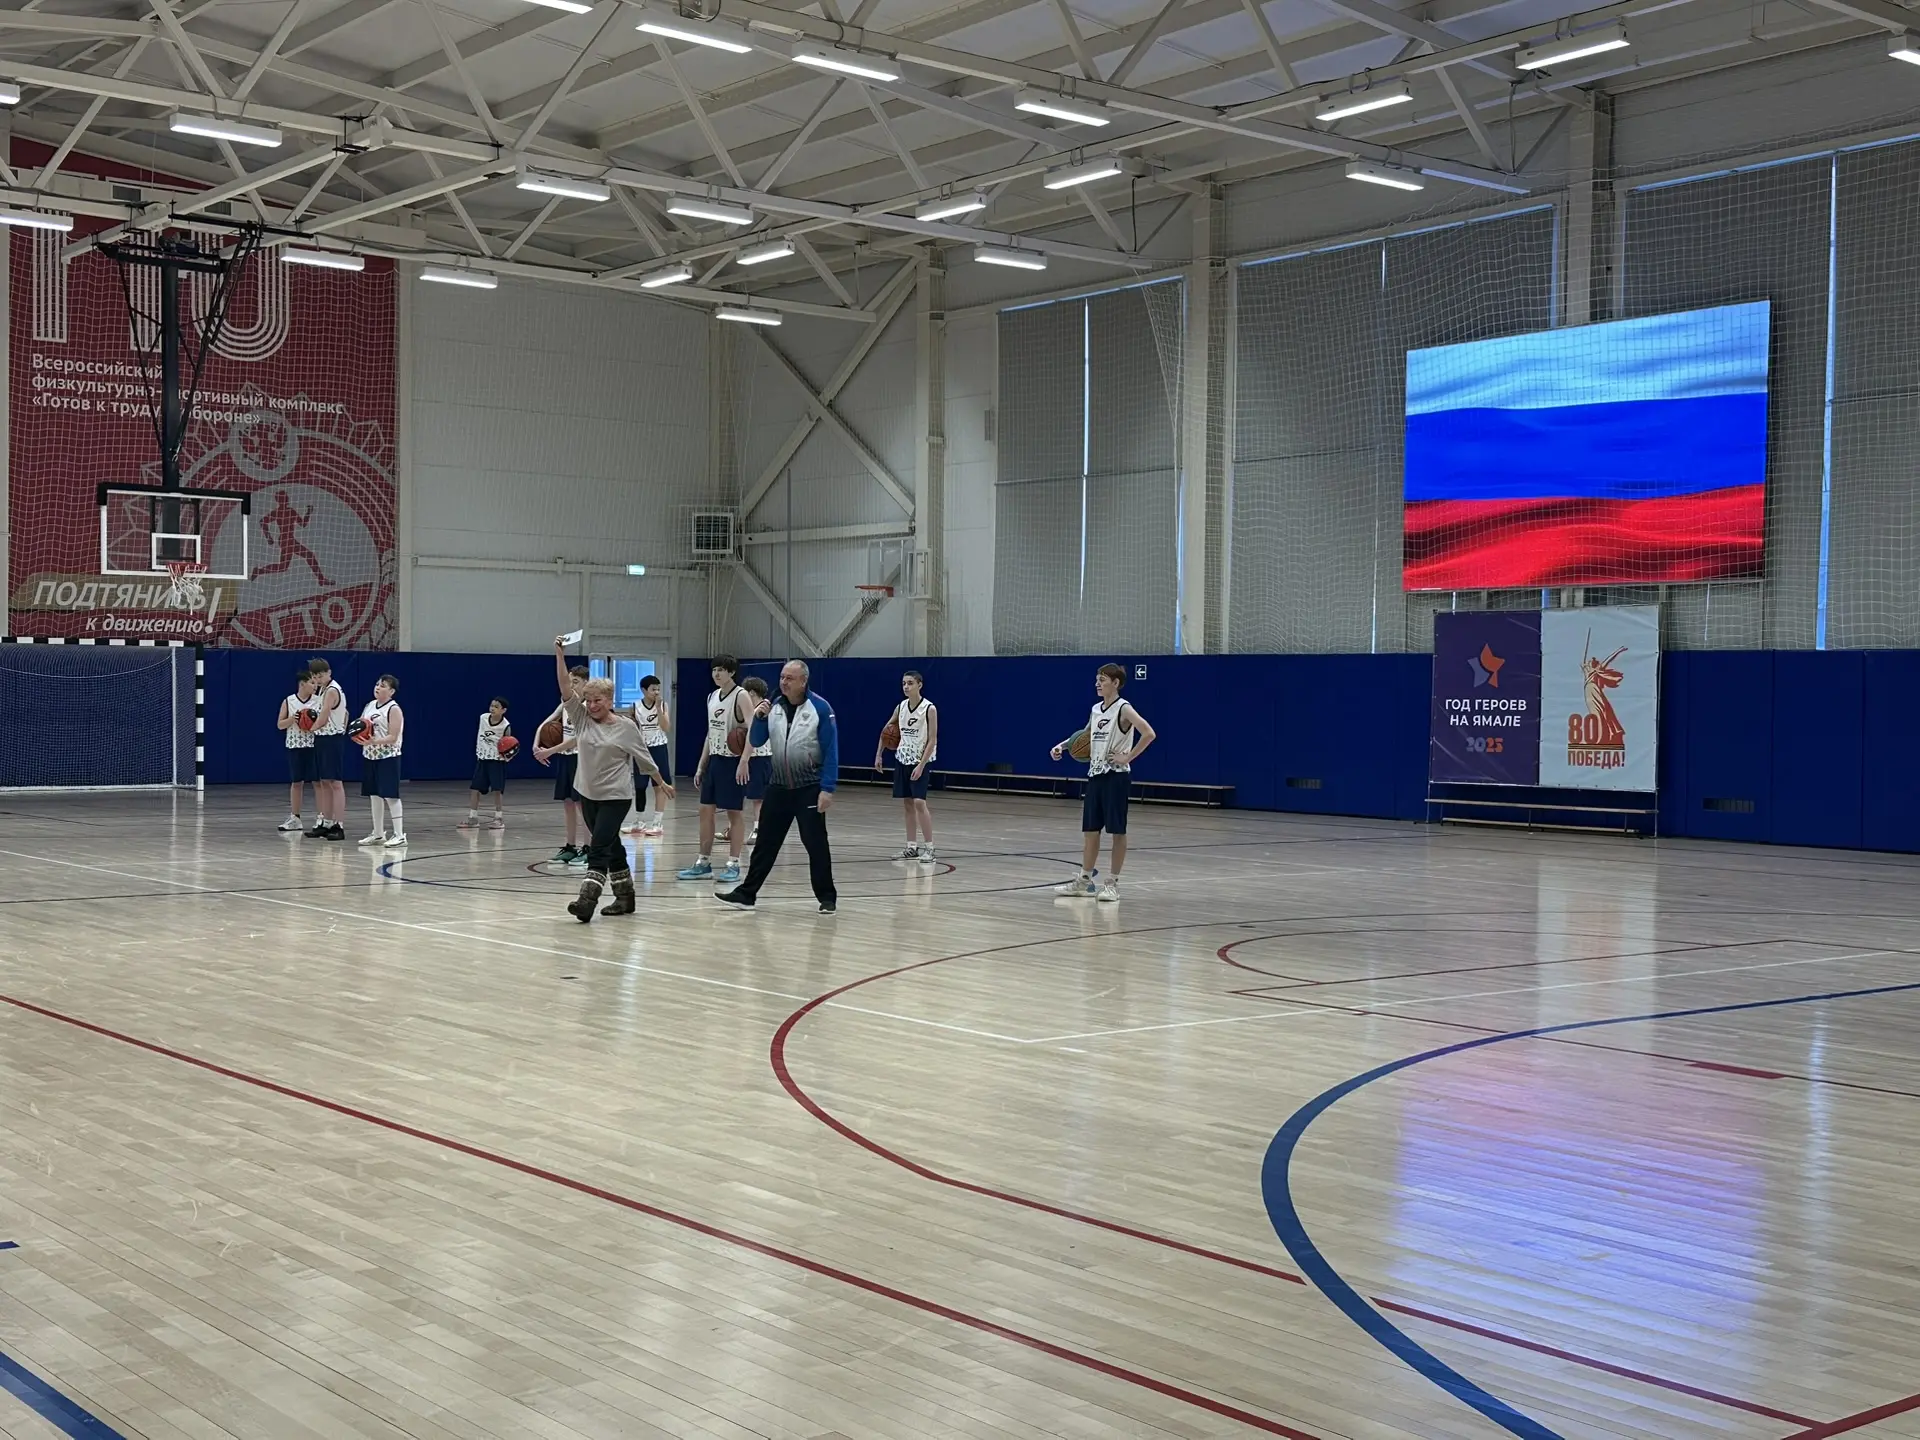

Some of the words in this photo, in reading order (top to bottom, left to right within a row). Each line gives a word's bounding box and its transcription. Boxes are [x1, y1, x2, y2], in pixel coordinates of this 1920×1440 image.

[32, 353, 162, 379] Всероссийский
[32, 373, 264, 408] физкультурно-ортивный
[268, 397, 344, 415] комплекс
[32, 392, 91, 411] «Готов
[96, 400, 106, 412] к
[111, 401, 161, 418] труду
[189, 405, 261, 424] бороне»
[86, 617, 98, 631] к
[102, 613, 203, 633] движению
[269, 597, 352, 645] ГТО
[1445, 699, 1471, 712] ГОД
[1475, 699, 1527, 711] ГЕРОЕВ
[1450, 714, 1469, 726] НА
[1473, 715, 1521, 727] ЯМАЛЕ
[1568, 713, 1600, 744] 80
[1466, 736, 1504, 753] 2025
[1568, 750, 1625, 770] ПОБЕДА!
